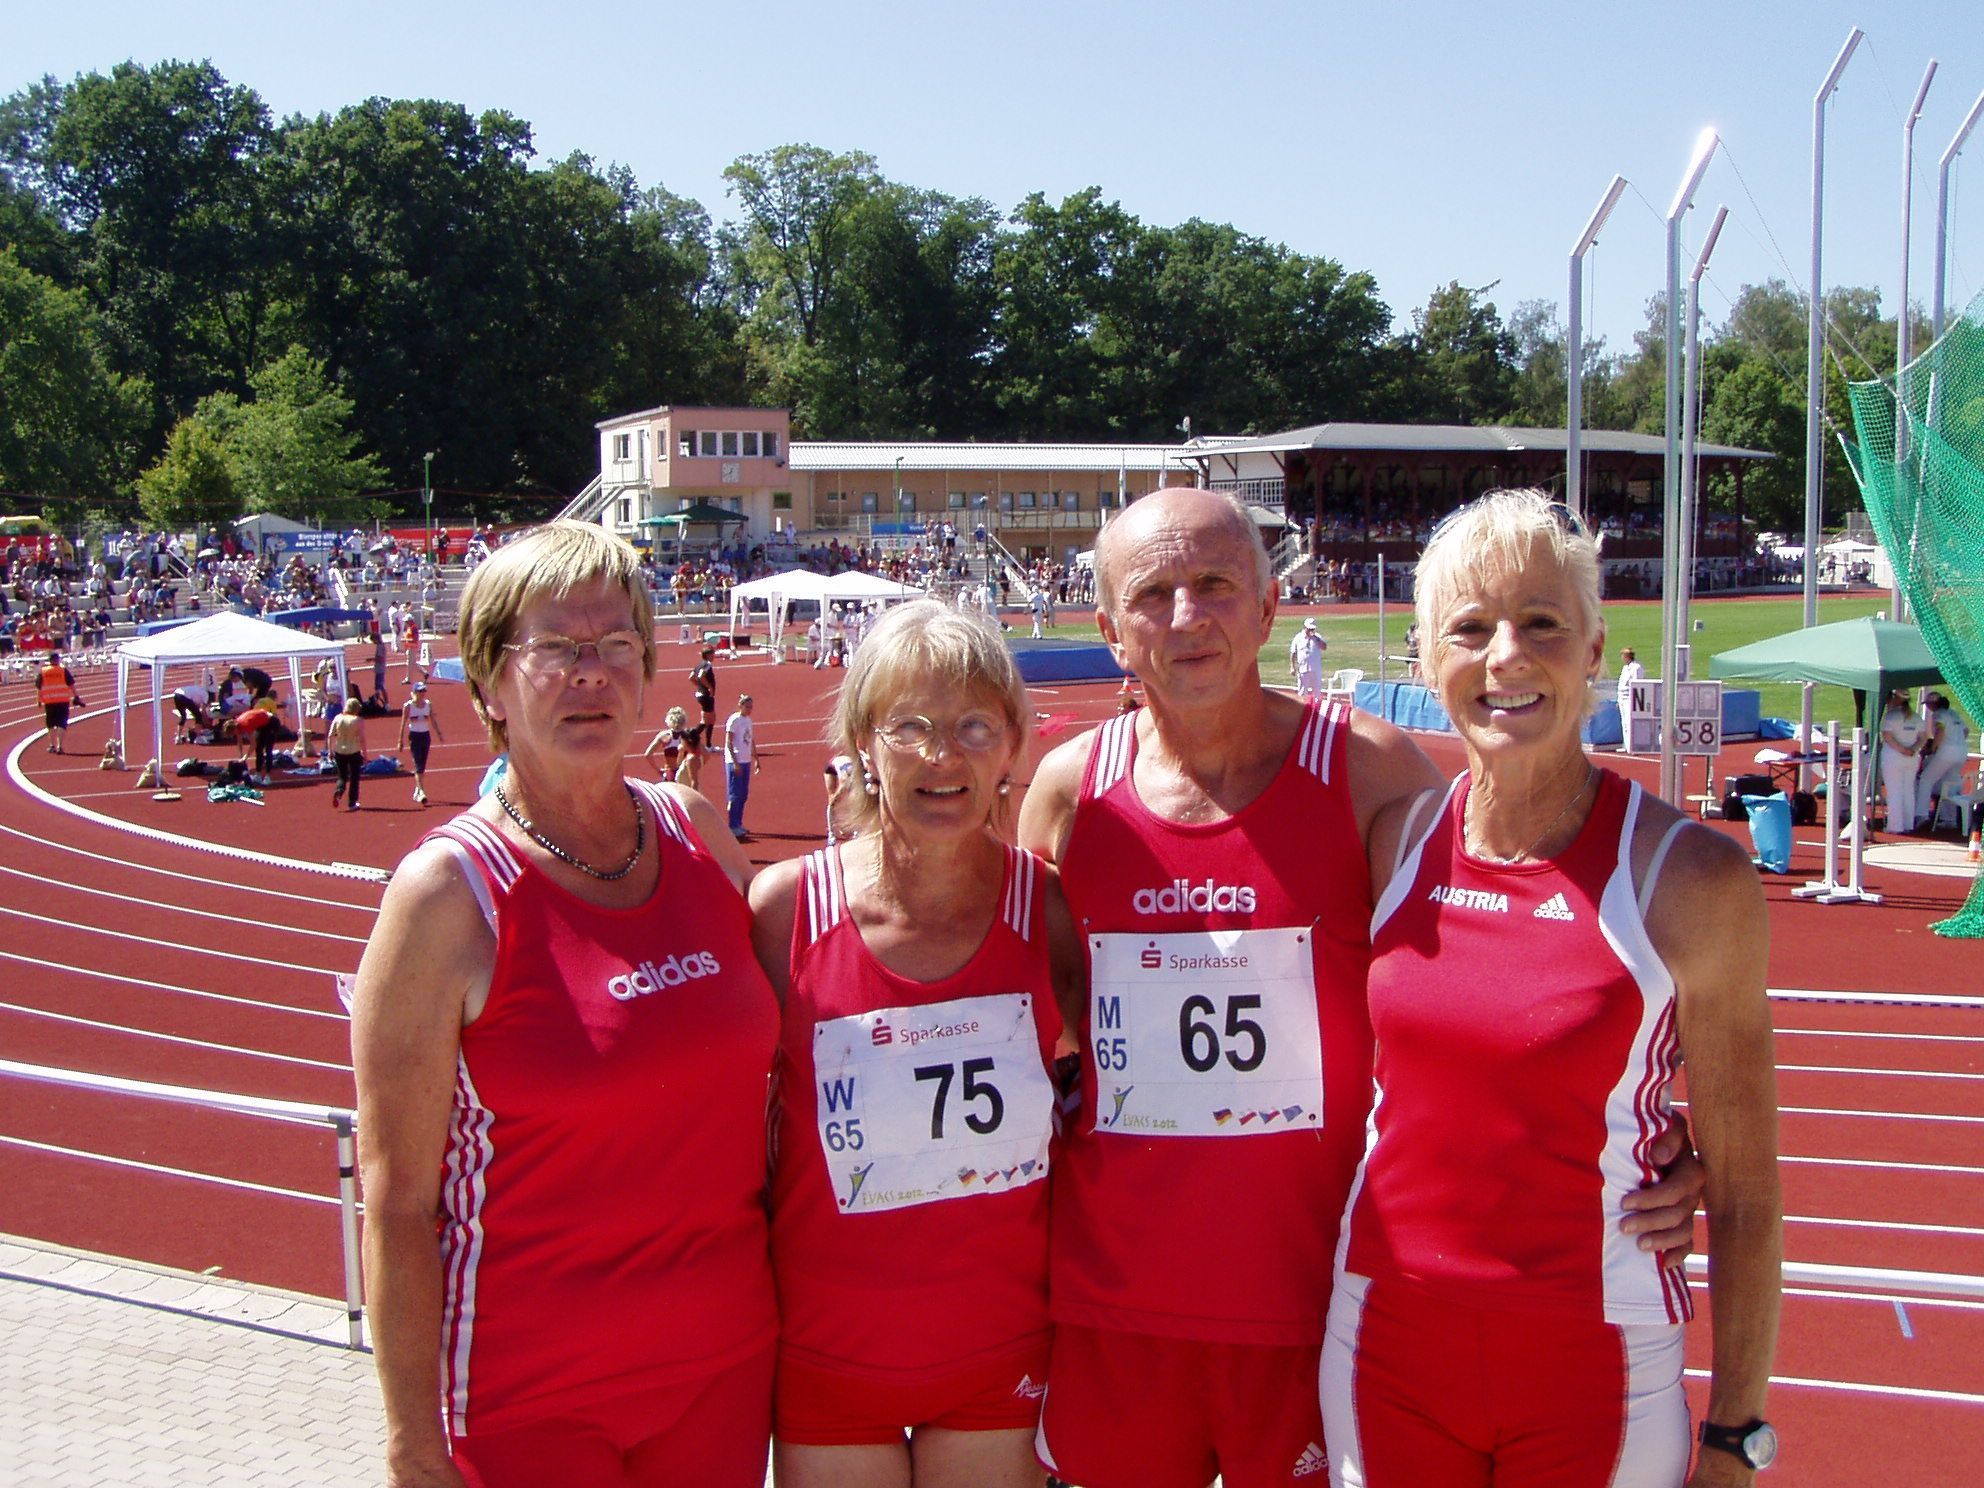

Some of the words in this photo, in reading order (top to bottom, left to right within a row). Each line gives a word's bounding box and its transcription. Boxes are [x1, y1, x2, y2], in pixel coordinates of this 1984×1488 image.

[1133, 878, 1257, 914] adidas
[1428, 884, 1509, 913] AUSTRIA
[1533, 908, 1575, 921] adidas
[607, 950, 721, 1001] adidas
[1169, 953, 1249, 972] Sparkasse
[1097, 995, 1121, 1030] M
[899, 1019, 980, 1046] Sparkasse
[1178, 993, 1267, 1073] 65
[1096, 1037, 1128, 1071] 65
[823, 1076, 855, 1113] W
[913, 1056, 1005, 1140] 75
[825, 1118, 865, 1152] 65
[1292, 1456, 1329, 1477] adida
